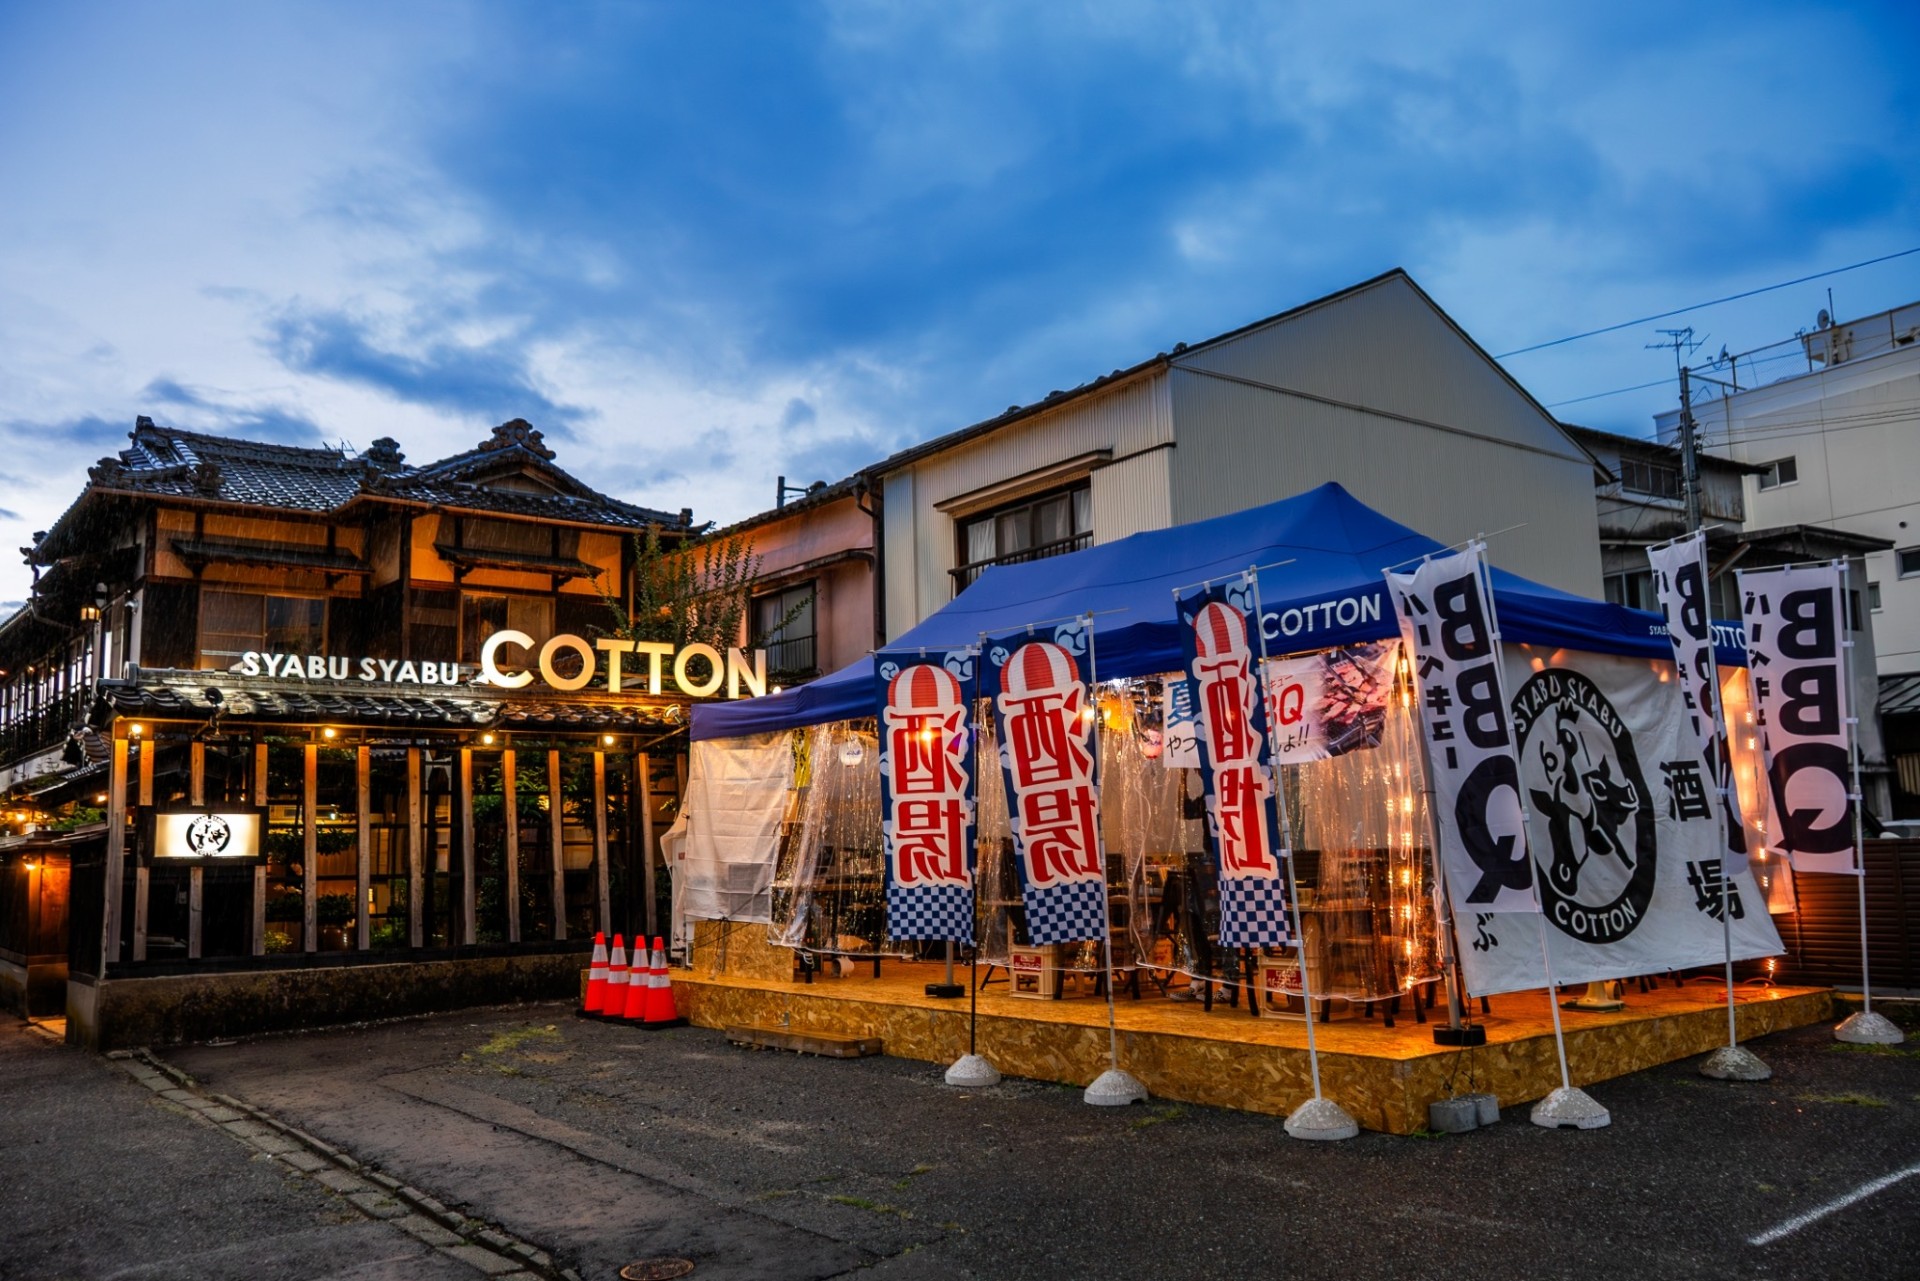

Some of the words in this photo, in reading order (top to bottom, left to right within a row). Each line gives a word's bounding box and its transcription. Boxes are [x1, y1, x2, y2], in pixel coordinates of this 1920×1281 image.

[1261, 593, 1381, 640] COTTON
[241, 651, 349, 679] SYABU
[359, 658, 459, 685] SYABU
[481, 629, 767, 699] COTTON
[1513, 675, 1561, 733] SYABU
[1567, 677, 1622, 738] SYABU
[1659, 759, 1745, 923] 酒場
[1555, 897, 1638, 937] COTTON
